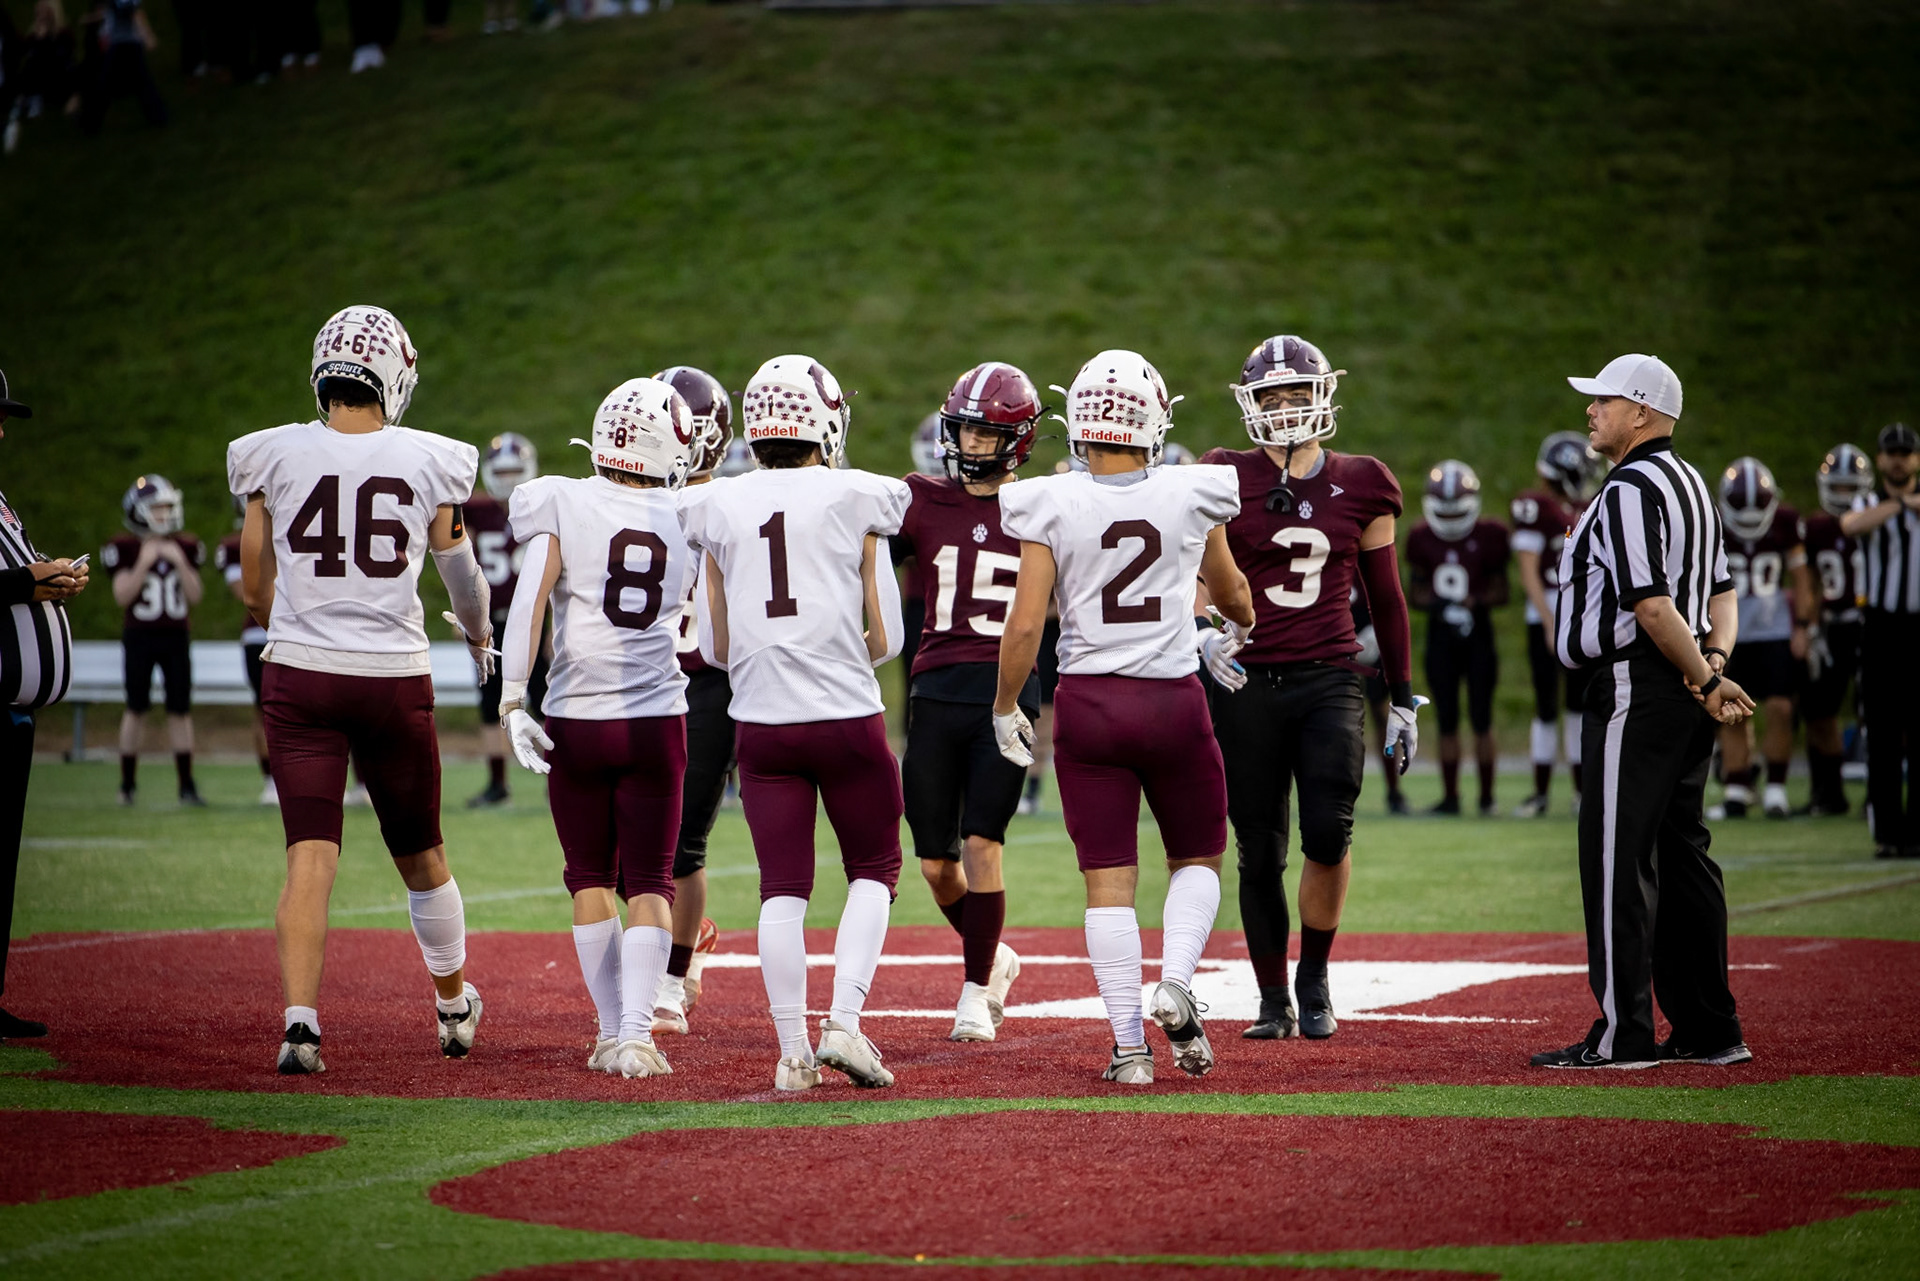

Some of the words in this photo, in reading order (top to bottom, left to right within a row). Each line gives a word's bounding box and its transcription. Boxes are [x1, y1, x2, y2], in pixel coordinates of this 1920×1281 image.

[328, 362, 364, 375] schutt
[1268, 370, 1293, 378] Riddell
[1101, 399, 1114, 420] 2
[614, 427, 627, 448] 8
[750, 426, 799, 438] Riddell
[1081, 429, 1132, 443] Riddell
[597, 453, 644, 473] Riddell
[286, 474, 415, 578] 46
[602, 527, 668, 631] 8
[759, 511, 798, 619] 1
[1101, 519, 1162, 624] 2
[1264, 526, 1331, 608] 3
[132, 570, 188, 621] 30
[932, 544, 1021, 636] 15
